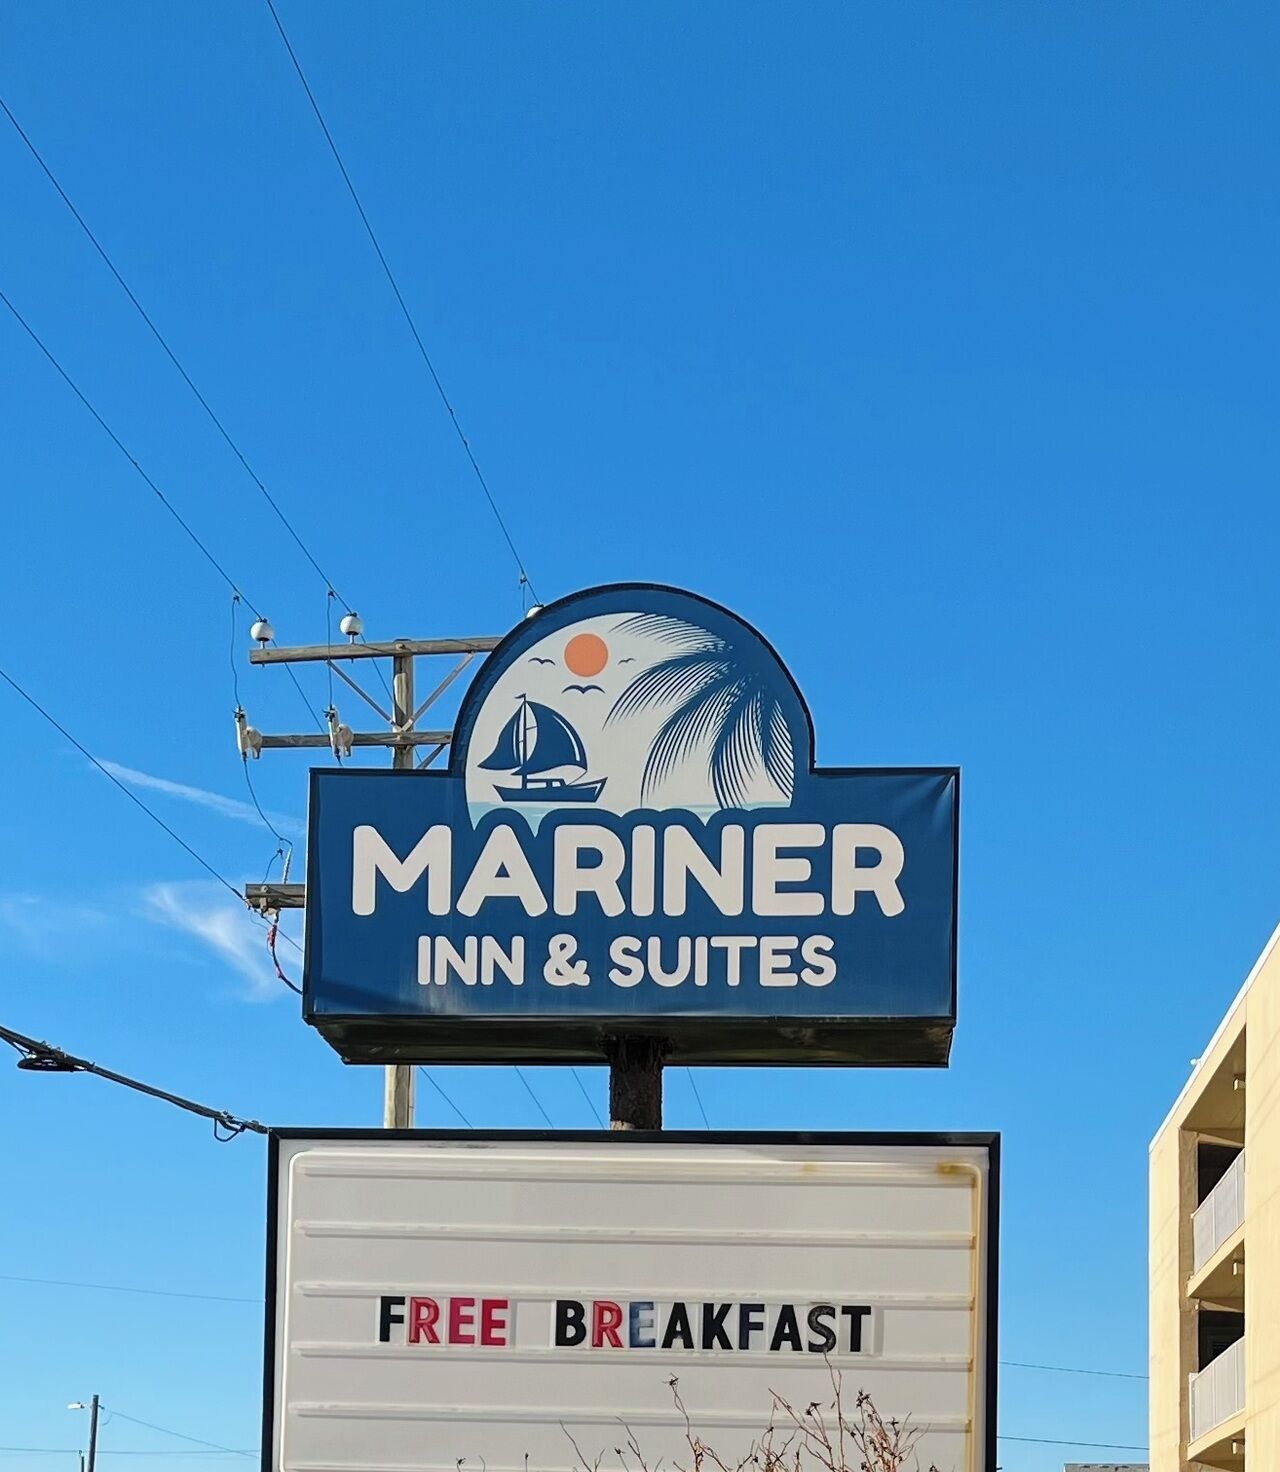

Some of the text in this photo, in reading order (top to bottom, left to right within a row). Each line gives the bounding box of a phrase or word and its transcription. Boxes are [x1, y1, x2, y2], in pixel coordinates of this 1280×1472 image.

[351, 823, 906, 918] MARINER
[417, 932, 838, 988] INN & SUITES
[378, 1295, 872, 1354] FREE BREAKFAST
